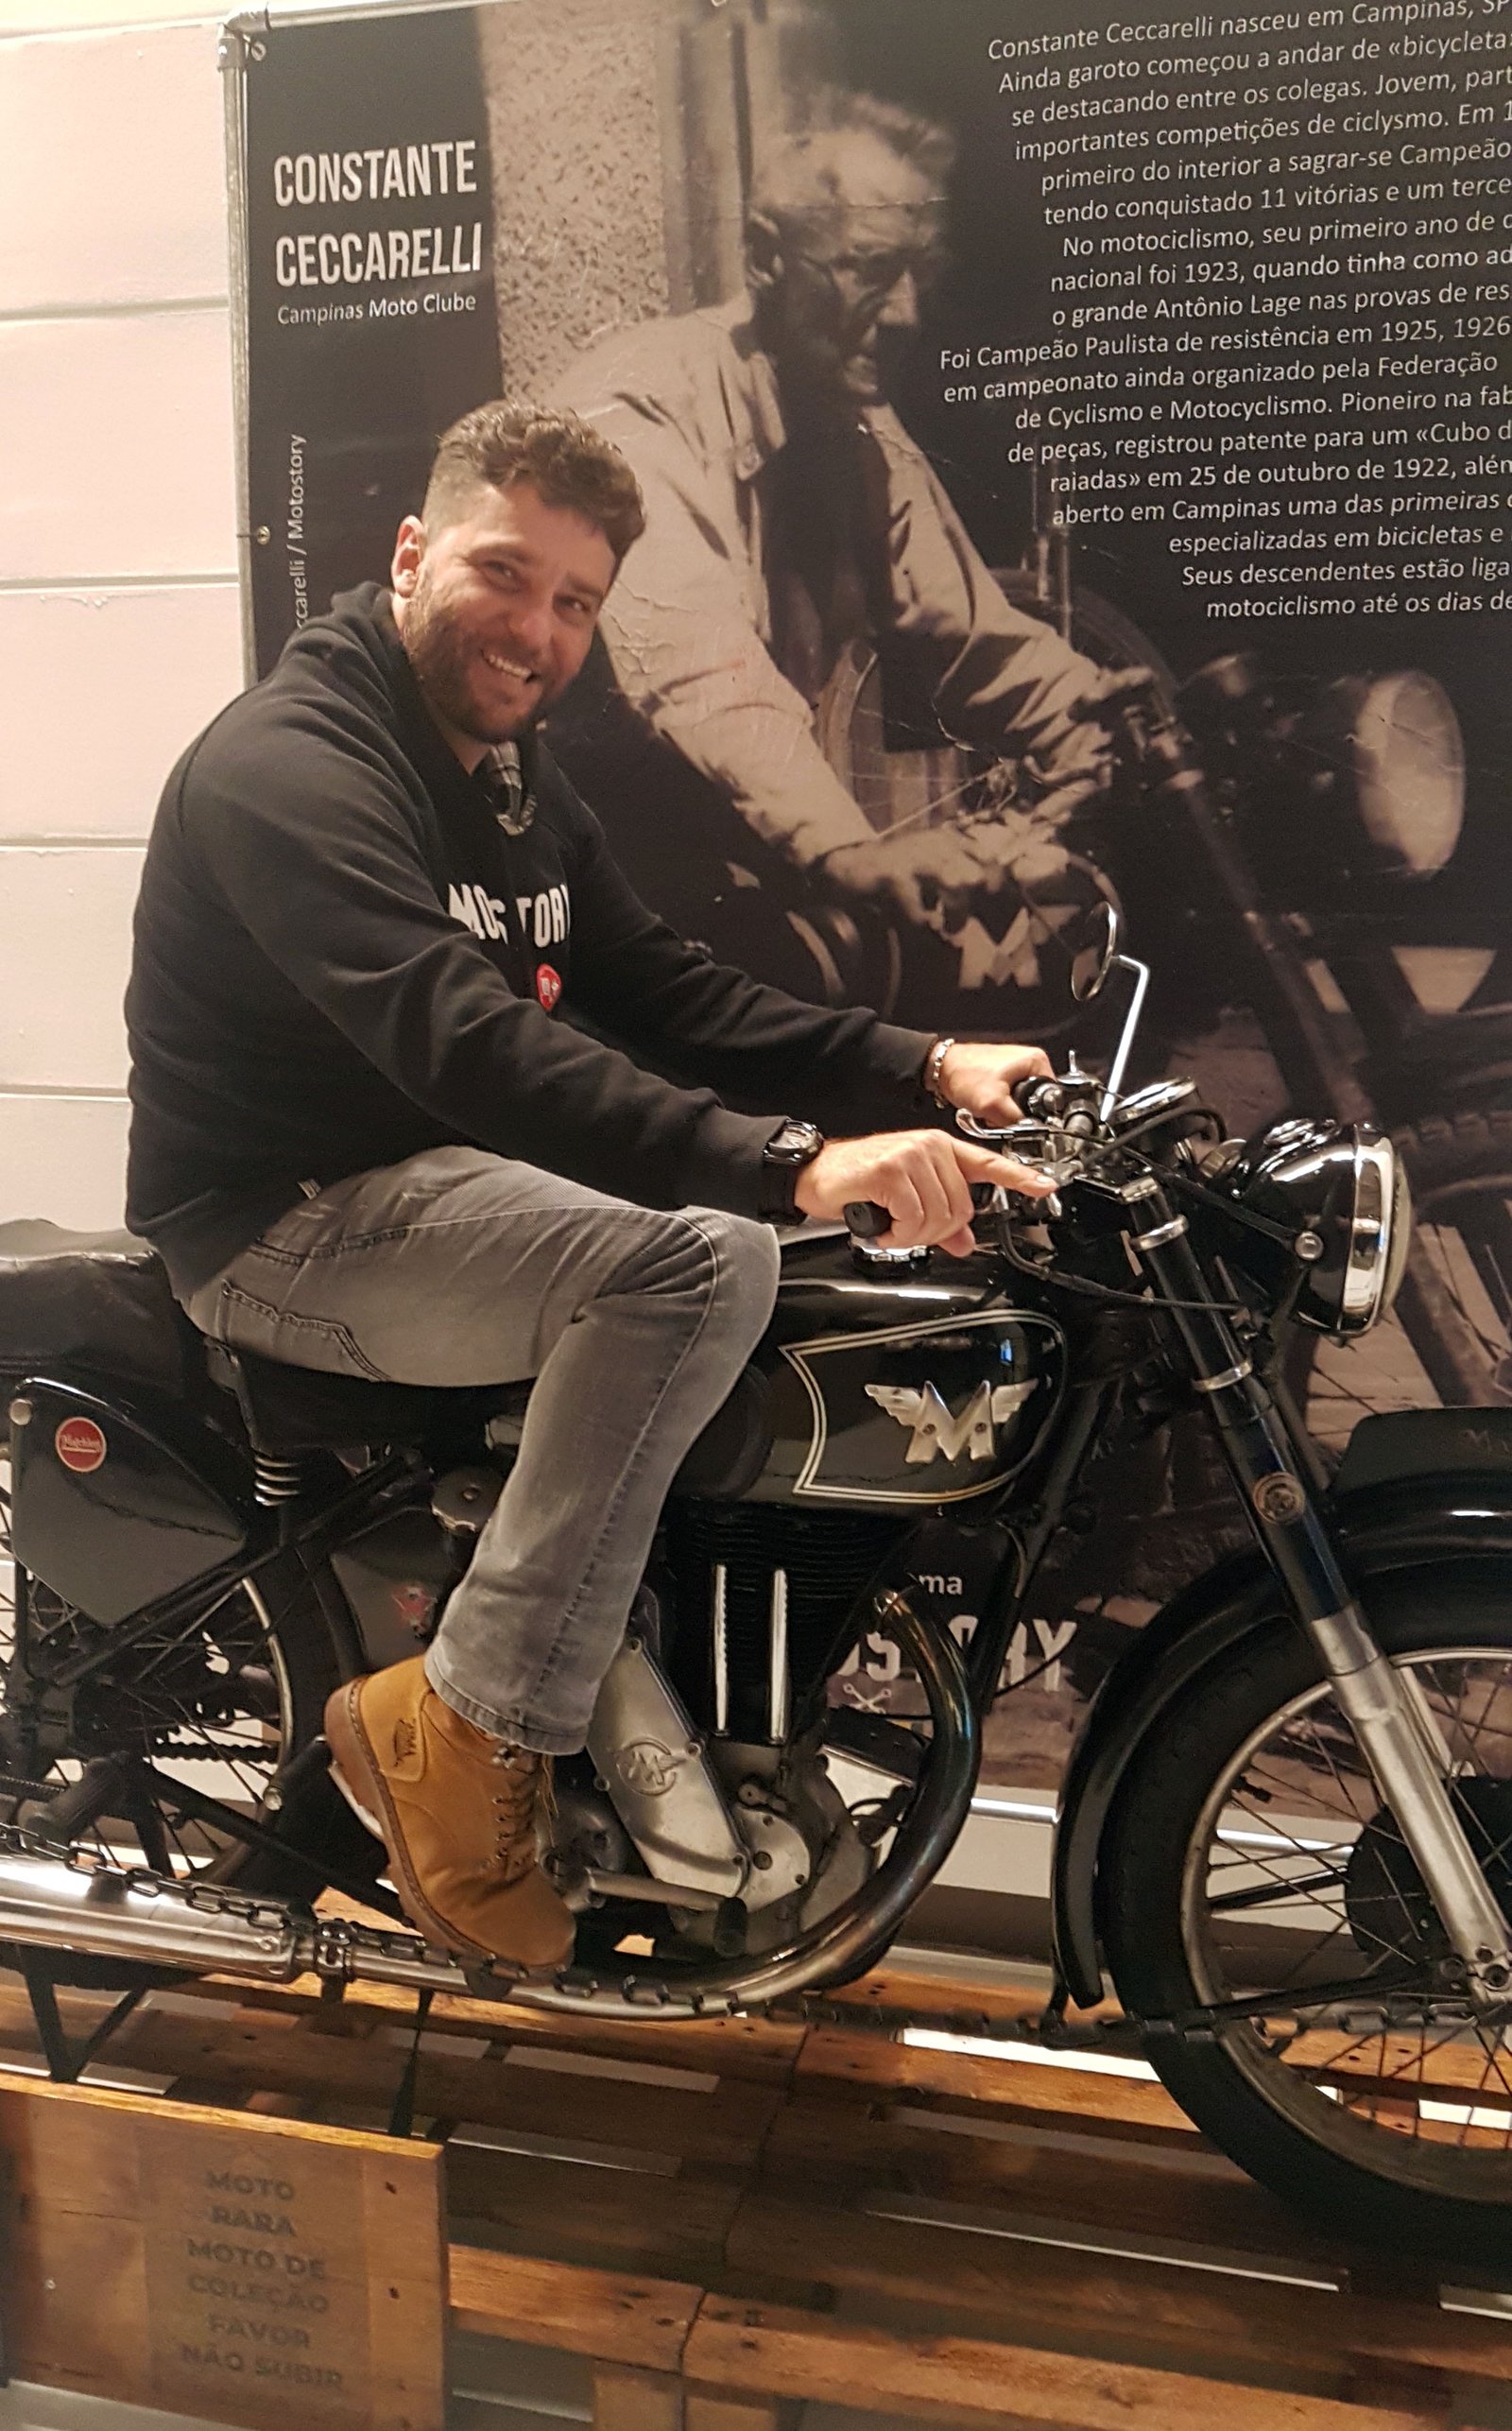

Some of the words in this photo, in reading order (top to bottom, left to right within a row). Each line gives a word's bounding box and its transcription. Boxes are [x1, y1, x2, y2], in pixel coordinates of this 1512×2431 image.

[988, 28, 1100, 60] Constante
[1106, 15, 1213, 43] Ceccarelli
[1221, 12, 1300, 36] nasceu
[1308, 9, 1344, 26] em
[1351, 0, 1474, 26] Campinas,
[998, 66, 1060, 94] Ainda
[1068, 59, 1141, 89] garoto
[1147, 53, 1249, 78] começou
[1257, 51, 1270, 68] a
[1278, 41, 1346, 66] andar
[1351, 38, 1381, 60] de
[1388, 30, 1512, 60] «bicycleta
[1011, 109, 1036, 127] se
[1041, 89, 1170, 123] destacando
[1176, 89, 1236, 110] entre
[1244, 87, 1269, 104] os
[1276, 78, 1367, 103] colegas.
[1374, 74, 1457, 95] Jovem,
[1015, 129, 1149, 163] importantes
[1157, 117, 1300, 148] competições
[1307, 112, 1336, 134] de
[1342, 109, 1450, 136] ciclysmo.
[1458, 103, 1494, 125] Em
[273, 139, 477, 207] CONSTANTE
[1041, 164, 1136, 197] primeiro
[1142, 159, 1170, 181] do
[1177, 155, 1263, 180] interior
[1268, 157, 1280, 174] a
[1288, 149, 1393, 175] sagrar-se
[1400, 137, 1512, 166] Campeão
[1043, 198, 1108, 225] tendo
[1115, 189, 1252, 221] conquistado
[1261, 187, 1286, 209] 11
[1295, 183, 1379, 206] vitórias
[1385, 185, 1400, 202] e
[1407, 181, 1444, 200] um
[1452, 177, 1512, 197] terce
[275, 222, 483, 287] CECCARELLI
[1063, 236, 1094, 257] No
[1100, 227, 1255, 254] motociclismo,
[1263, 226, 1301, 244] seu
[1309, 217, 1408, 246] primeiro
[1415, 217, 1458, 236] ano
[1465, 210, 1495, 233] de
[1051, 263, 1142, 293] nacional
[1148, 263, 1177, 284] foi
[1185, 261, 1246, 284] 1923,
[1253, 253, 1340, 284] quando
[1346, 250, 1406, 274] tinha
[1413, 251, 1479, 269] como
[277, 302, 364, 327] Campinas
[369, 297, 418, 319] Moto
[423, 291, 476, 315] Clube
[1052, 309, 1067, 326] o
[1072, 299, 1148, 329] grande
[1153, 295, 1244, 319] Antônio
[1250, 294, 1301, 318] Lage
[1308, 293, 1348, 310] nas
[1354, 288, 1431, 314] provas
[1438, 282, 1469, 303] de
[1474, 284, 1512, 302] res
[940, 348, 971, 371] Foi
[977, 338, 1078, 367] Campeão
[1085, 333, 1169, 357] Paulista
[1176, 331, 1204, 352] de
[1210, 325, 1330, 351] resistência
[1336, 327, 1372, 344] em
[1381, 319, 1444, 343] 1925,
[1453, 316, 1511, 338] 1926
[943, 385, 977, 403] em
[983, 371, 1119, 401] campeonato
[1125, 365, 1185, 388] ainda
[1191, 359, 1315, 389] organizado
[1322, 357, 1370, 384] pela
[1378, 351, 1498, 378] Federação
[1015, 408, 1041, 429] de
[1048, 403, 1143, 431] Cyclismo
[1149, 405, 1162, 421] e
[1170, 395, 1332, 422] Motocyclismo.
[1341, 389, 1436, 412] Pioneiro
[1444, 391, 1472, 408] na
[1006, 441, 1037, 463] de
[1041, 440, 1108, 465] peças,
[1115, 433, 1213, 459] registrou
[1220, 430, 1307, 456] patente
[1314, 431, 1365, 453] para
[1372, 429, 1408, 446] um
[1416, 420, 1491, 443] «Cubo
[287, 434, 307, 540] Motostory
[1051, 469, 1141, 493] raiadas»
[1147, 471, 1182, 488] em
[1189, 465, 1217, 486] 25
[1223, 463, 1251, 486] de
[1257, 461, 1350, 484] outubro
[1357, 458, 1385, 480] de
[1393, 457, 1457, 480] 1922,
[1053, 503, 1125, 527] aberto
[1130, 505, 1165, 522] em
[1172, 497, 1281, 524] Campinas
[1288, 499, 1337, 516] uma
[1344, 492, 1383, 514] das
[1390, 490, 1500, 517] primeiras
[1168, 528, 1328, 557] especializadas
[1333, 531, 1369, 548] em
[1377, 524, 1484, 546] bicicletas
[1489, 527, 1504, 543] e
[1181, 566, 1234, 586] Seus
[1240, 560, 1396, 584] descendentes
[1402, 558, 1465, 579] estão
[1471, 556, 1512, 582] liga
[1207, 595, 1356, 618] motociclismo
[1363, 592, 1399, 614] até
[1404, 597, 1431, 612] os
[1436, 591, 1484, 612] dias
[206, 2171, 294, 2200] MOTO
[211, 2206, 298, 2237] RARA
[187, 2238, 276, 2269] MOTO
[284, 2254, 326, 2281] DE
[208, 2314, 310, 2348] FAVOR
